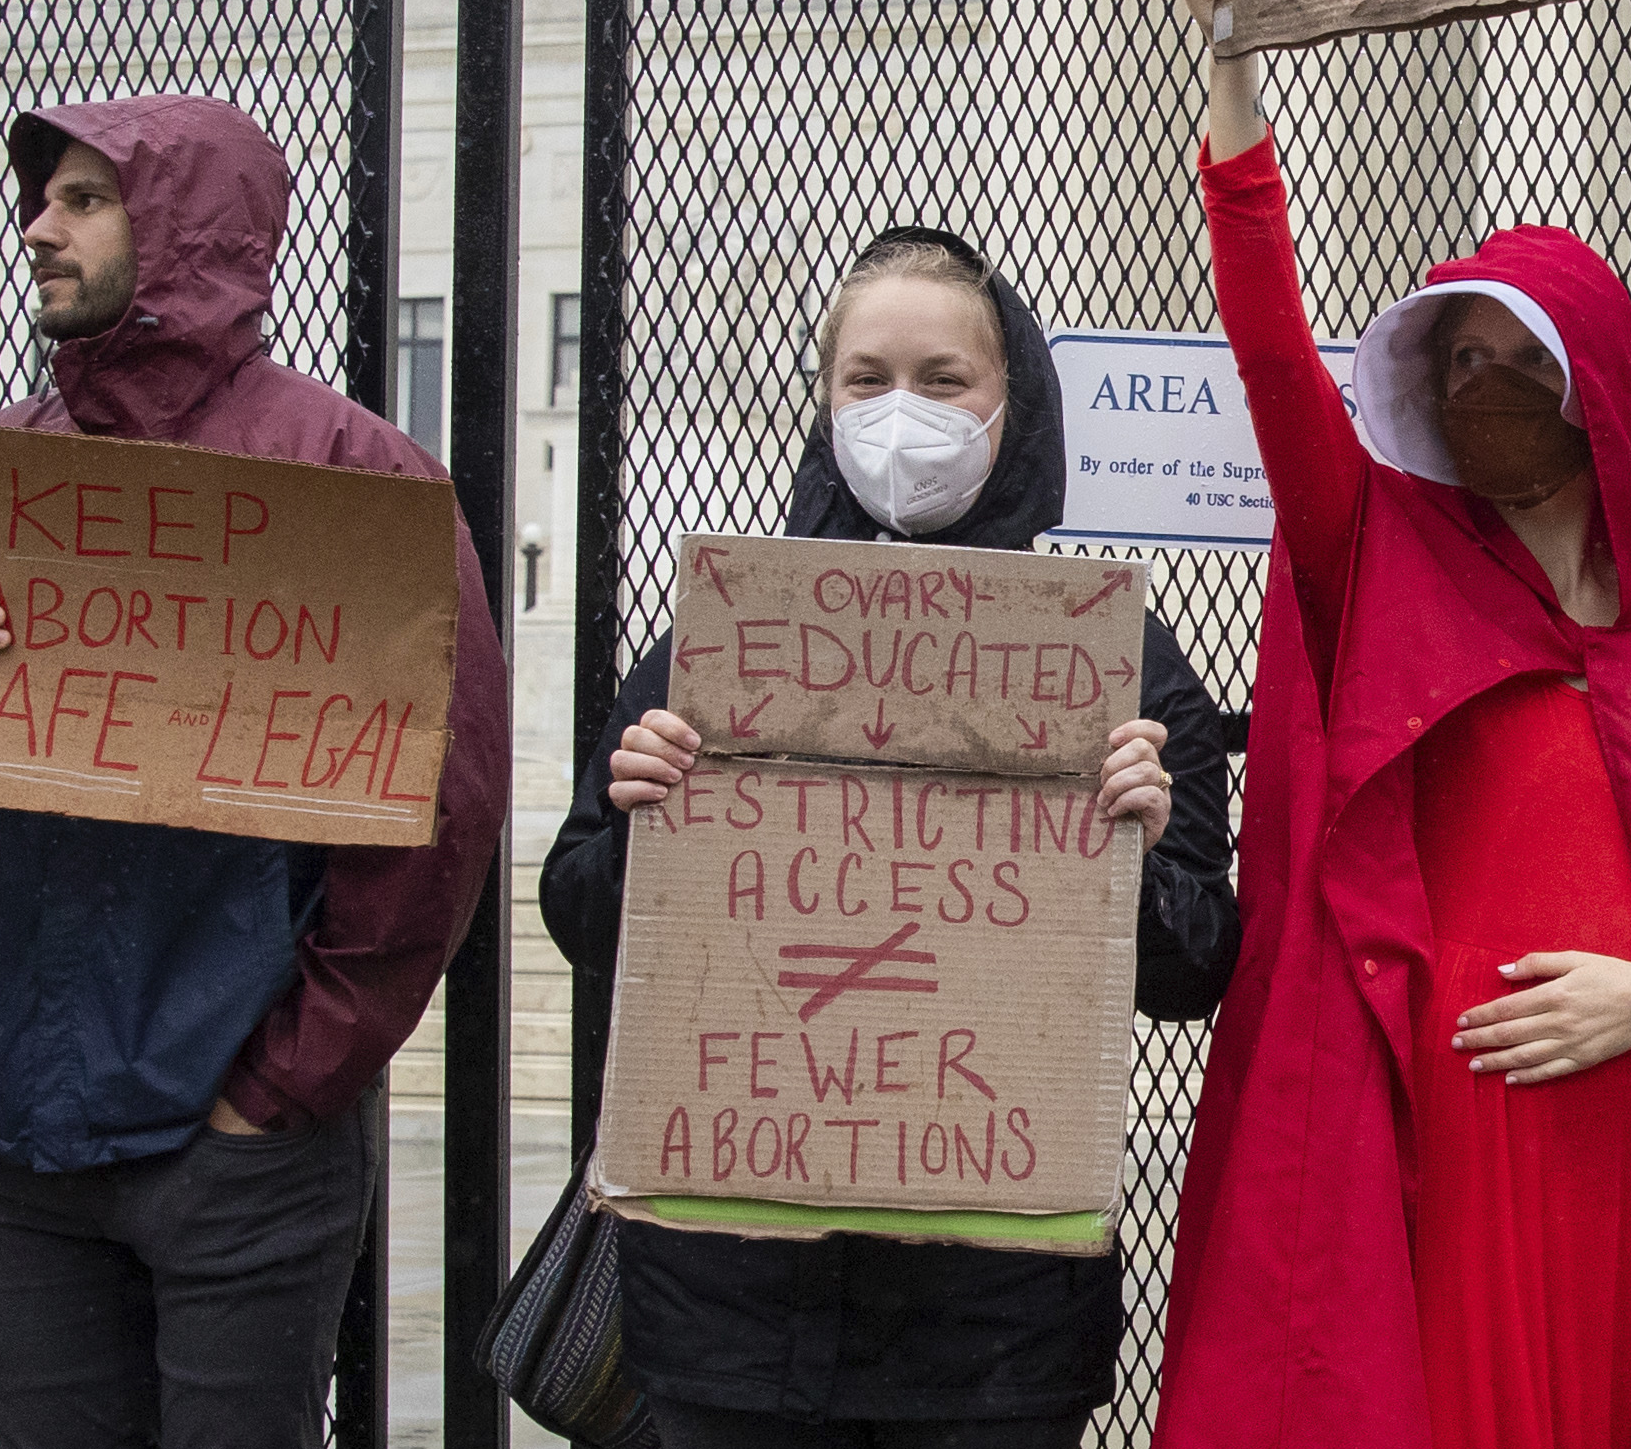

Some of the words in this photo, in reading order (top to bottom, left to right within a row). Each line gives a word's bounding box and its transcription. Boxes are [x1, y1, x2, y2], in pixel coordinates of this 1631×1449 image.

[1089, 373, 1221, 415] AREA
[1079, 455, 1101, 475] By
[1109, 458, 1154, 475] order
[1162, 459, 1181, 476] of
[1189, 461, 1215, 477] the
[1186, 492, 1200, 506] 40
[1207, 493, 1234, 506] USC
[8, 467, 269, 564] KEEP
[813, 567, 996, 622] OVARY-
[736, 619, 1103, 710] EDUCATED
[169, 709, 210, 728] AND
[196, 681, 431, 802] LEGAL
[728, 847, 1030, 927] ACCESS
[698, 1027, 998, 1106] FEWER
[660, 1106, 1037, 1186] ABORTIONS
